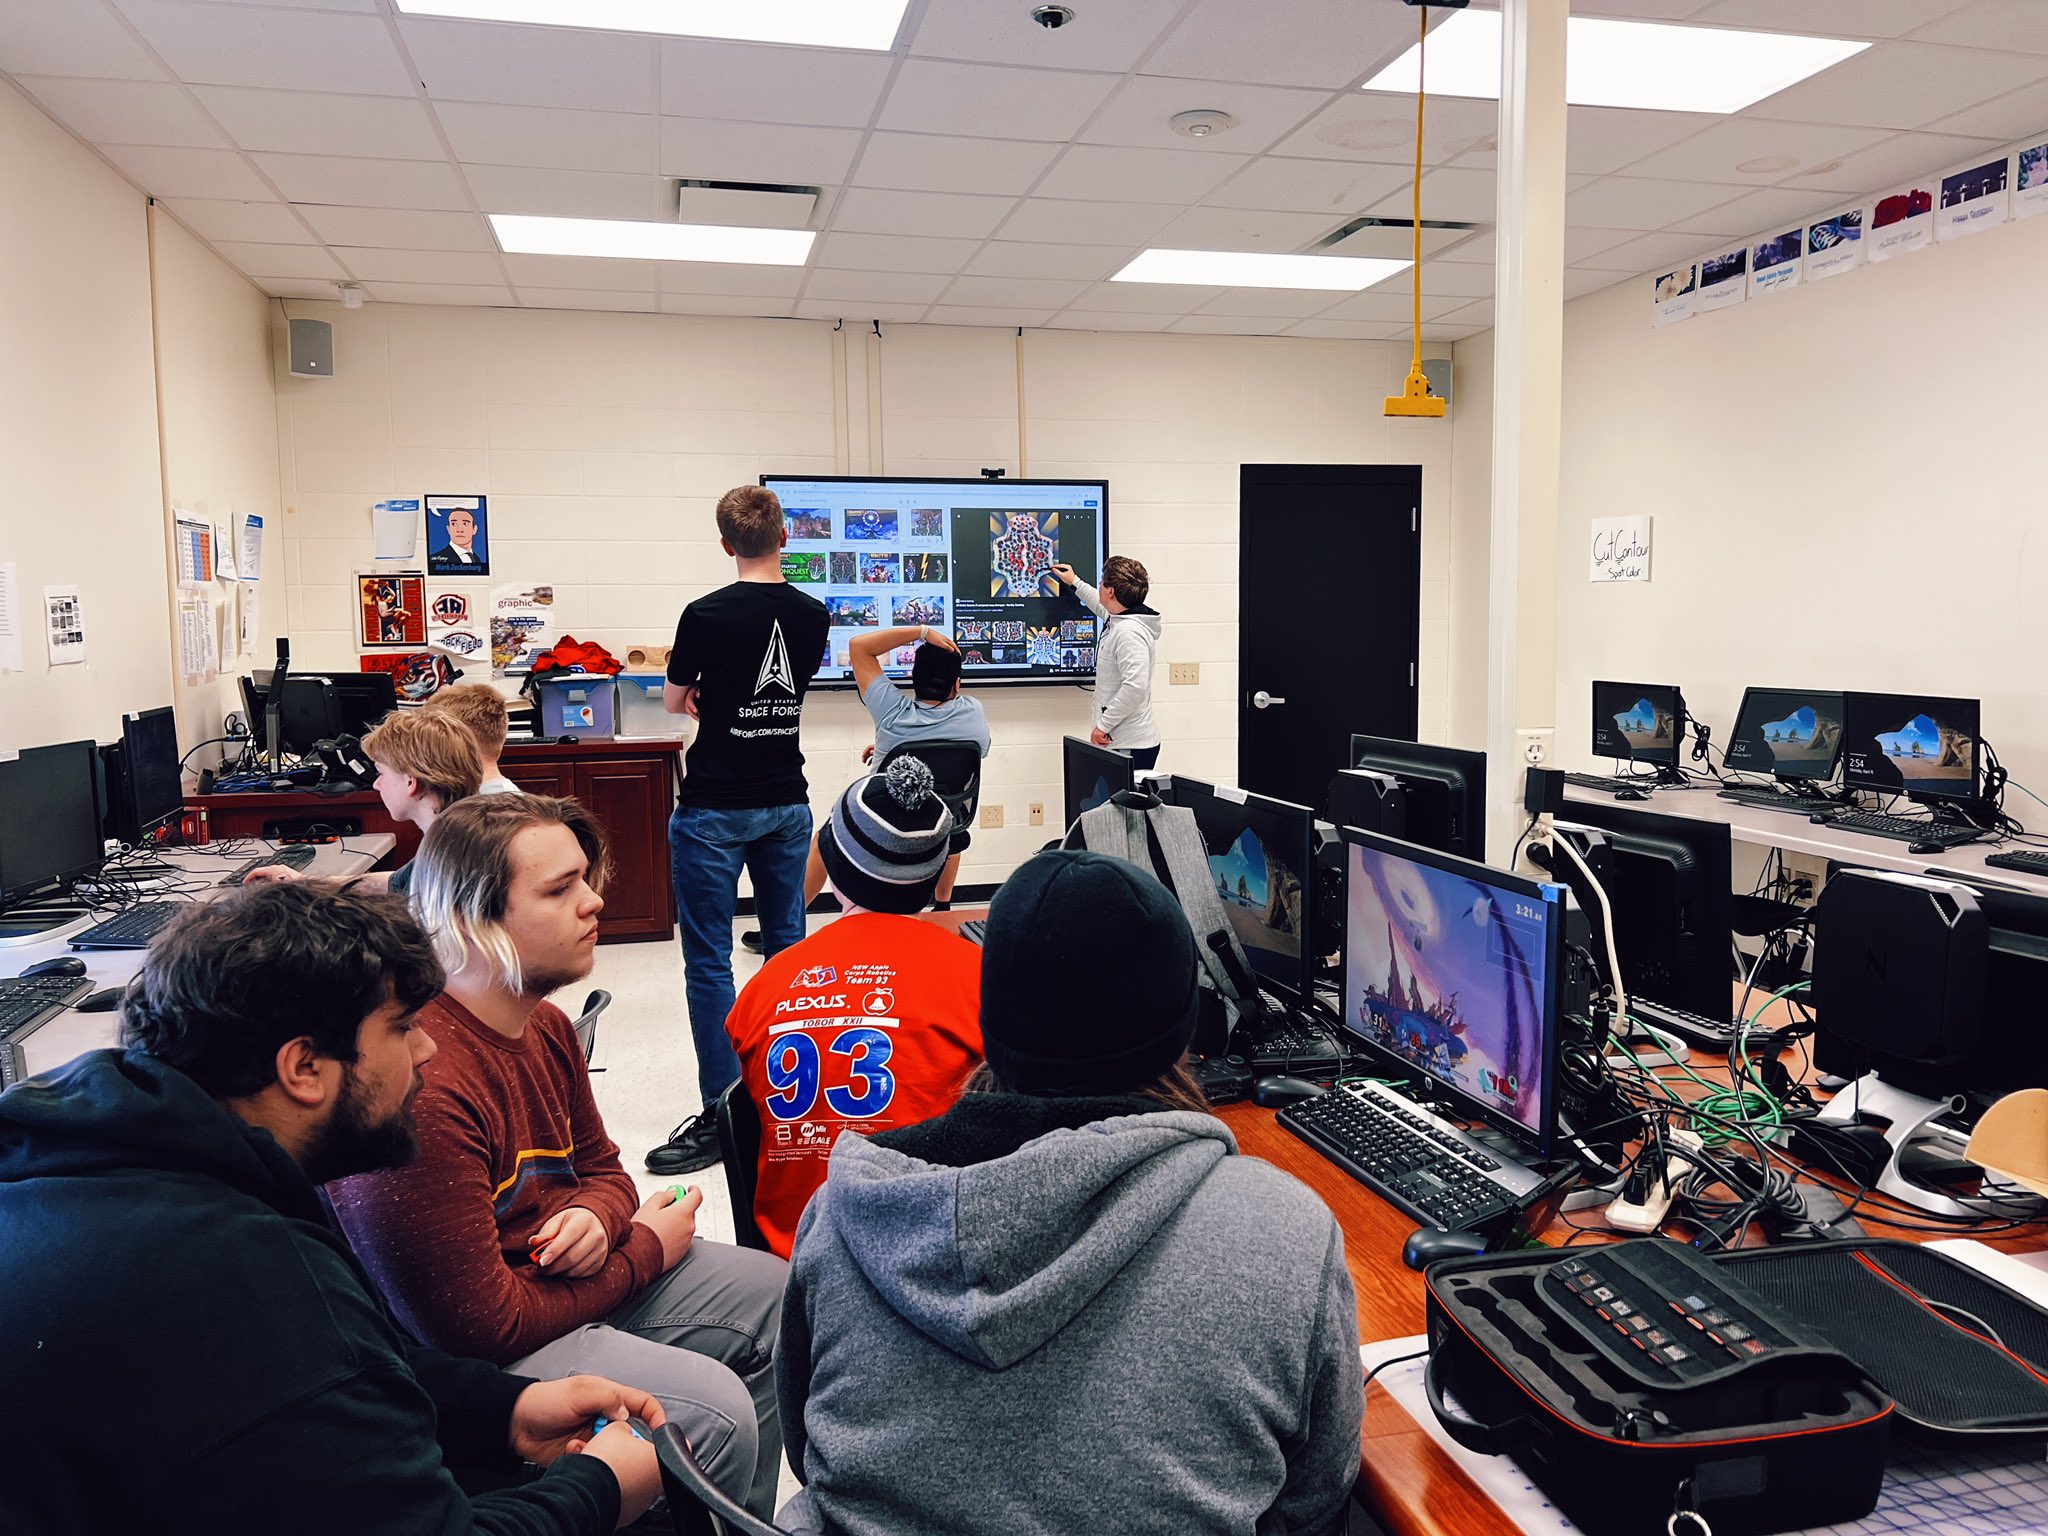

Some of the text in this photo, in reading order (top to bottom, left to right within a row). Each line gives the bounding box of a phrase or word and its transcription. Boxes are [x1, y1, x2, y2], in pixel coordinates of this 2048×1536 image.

[1608, 566, 1641, 579] Spot Color
[498, 600, 533, 608] graphic
[461, 638, 482, 651] FIELD
[738, 706, 768, 718] SPACE
[1733, 744, 1746, 753] 3:54
[1849, 758, 1865, 768] 2:54
[870, 964, 889, 972] Apple
[846, 976, 888, 985] Team 93
[775, 994, 847, 1016] PLEXUS
[802, 1017, 863, 1028] TOBOR XXII
[765, 1027, 896, 1121] 93
